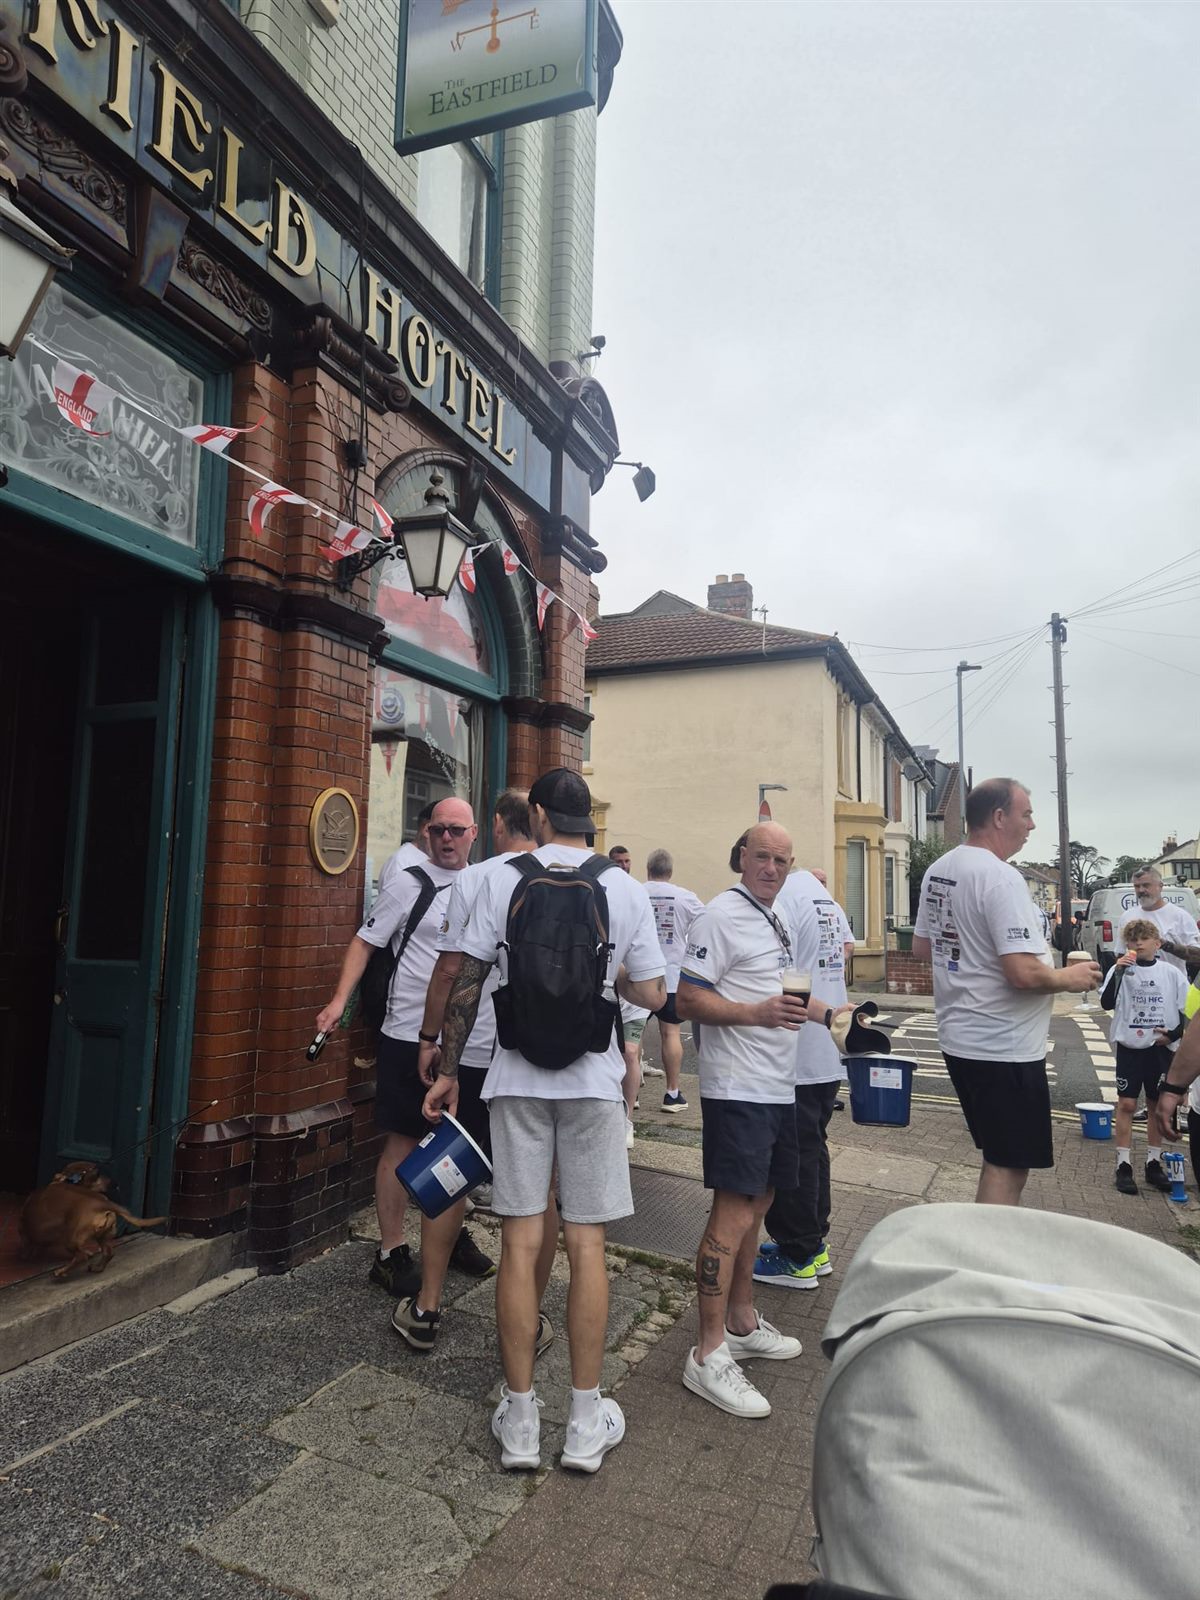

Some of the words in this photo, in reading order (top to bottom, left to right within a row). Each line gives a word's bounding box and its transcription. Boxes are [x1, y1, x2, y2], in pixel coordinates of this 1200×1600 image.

[428, 63, 558, 116] EASTFIELD
[444, 78, 465, 90] THE
[364, 267, 517, 465] HOTEL
[57, 394, 92, 422] ENGLAND
